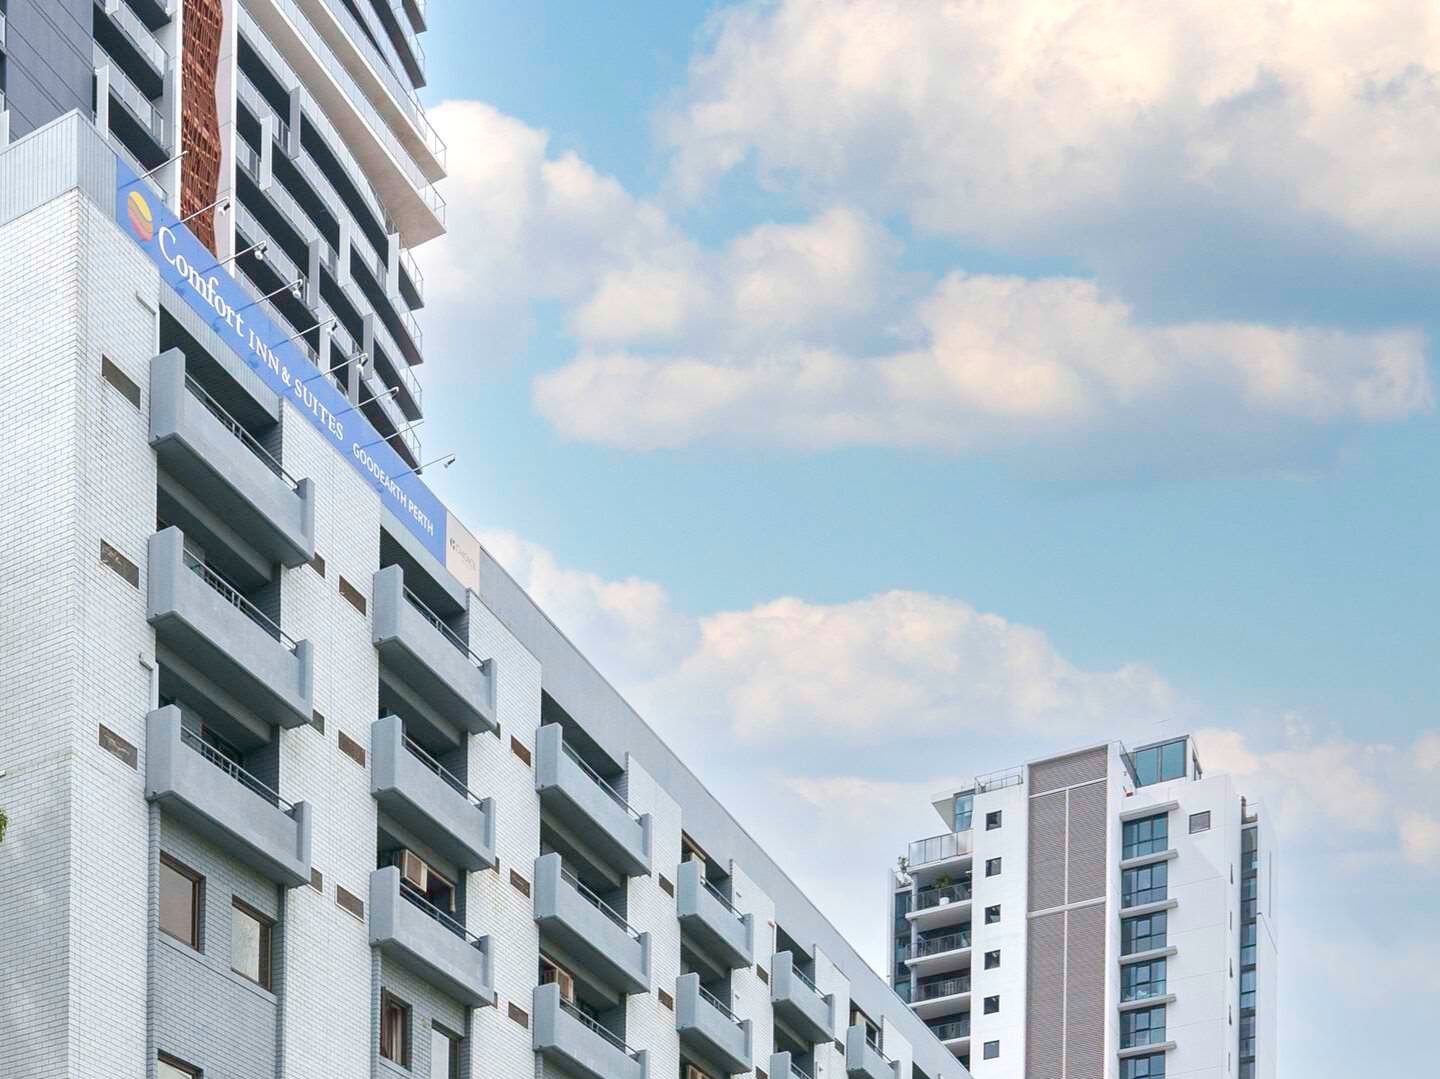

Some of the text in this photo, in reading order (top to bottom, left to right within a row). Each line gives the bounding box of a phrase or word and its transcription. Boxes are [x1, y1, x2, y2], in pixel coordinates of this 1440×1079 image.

[159, 226, 434, 537] Comfort INN & SUITES GOODEARTH PERTH
